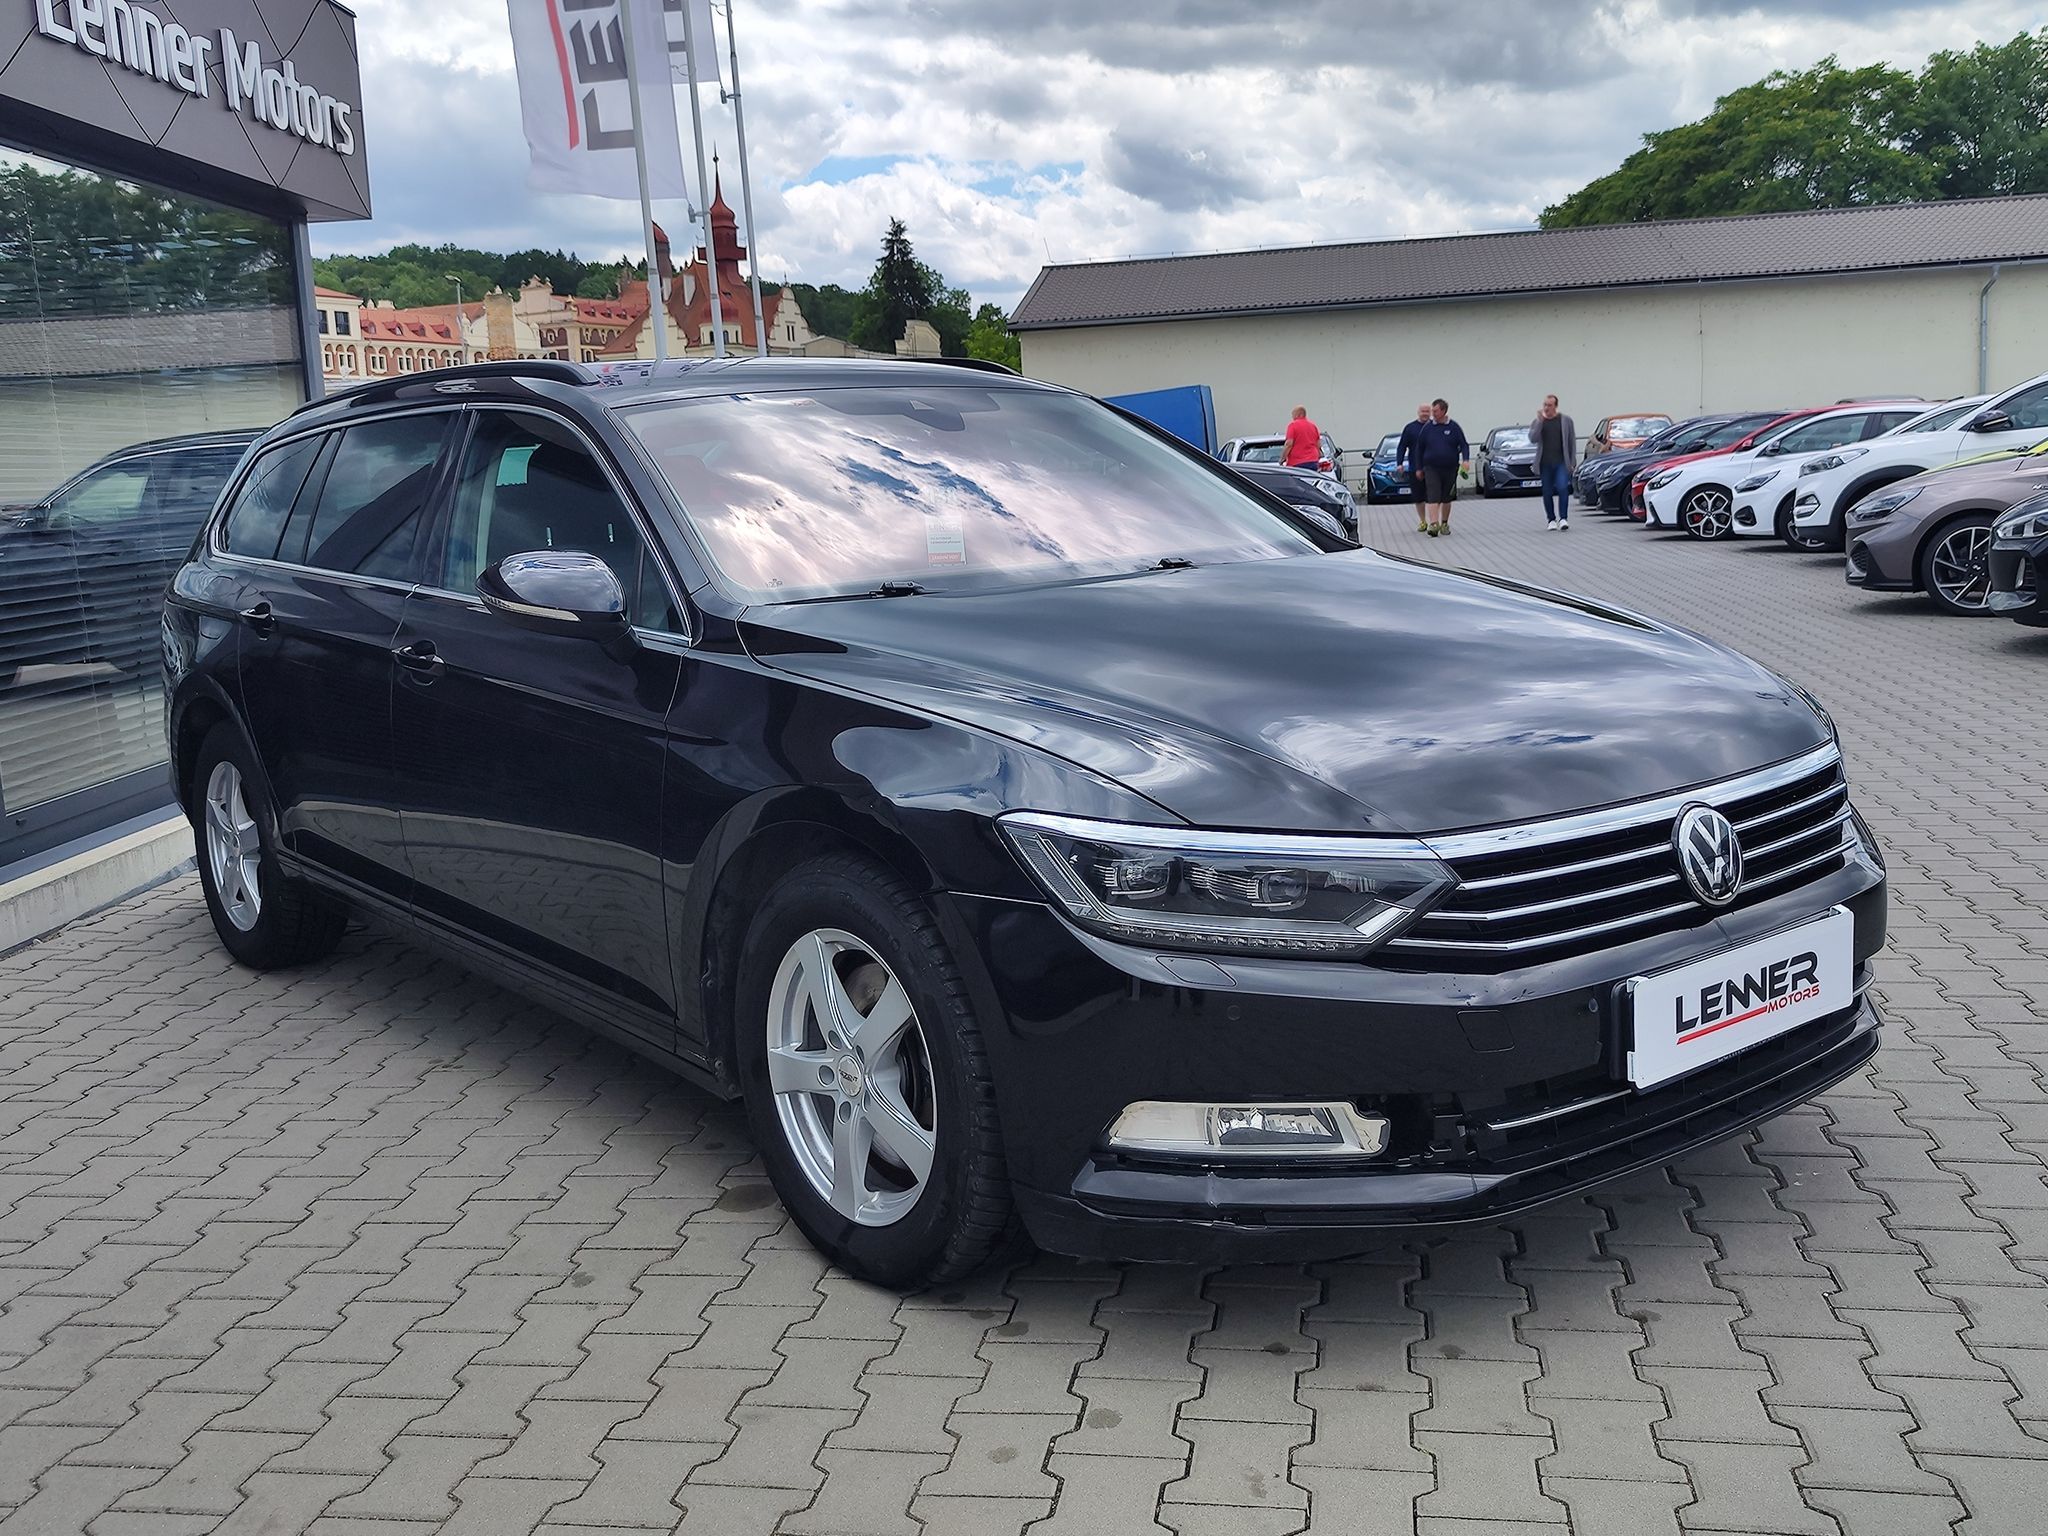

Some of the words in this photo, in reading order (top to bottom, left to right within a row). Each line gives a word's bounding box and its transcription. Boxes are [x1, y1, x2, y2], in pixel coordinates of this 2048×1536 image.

[218, 27, 355, 155] Motors
[1675, 951, 1819, 1035] LENNER
[1766, 983, 1820, 1014] MOTORS
